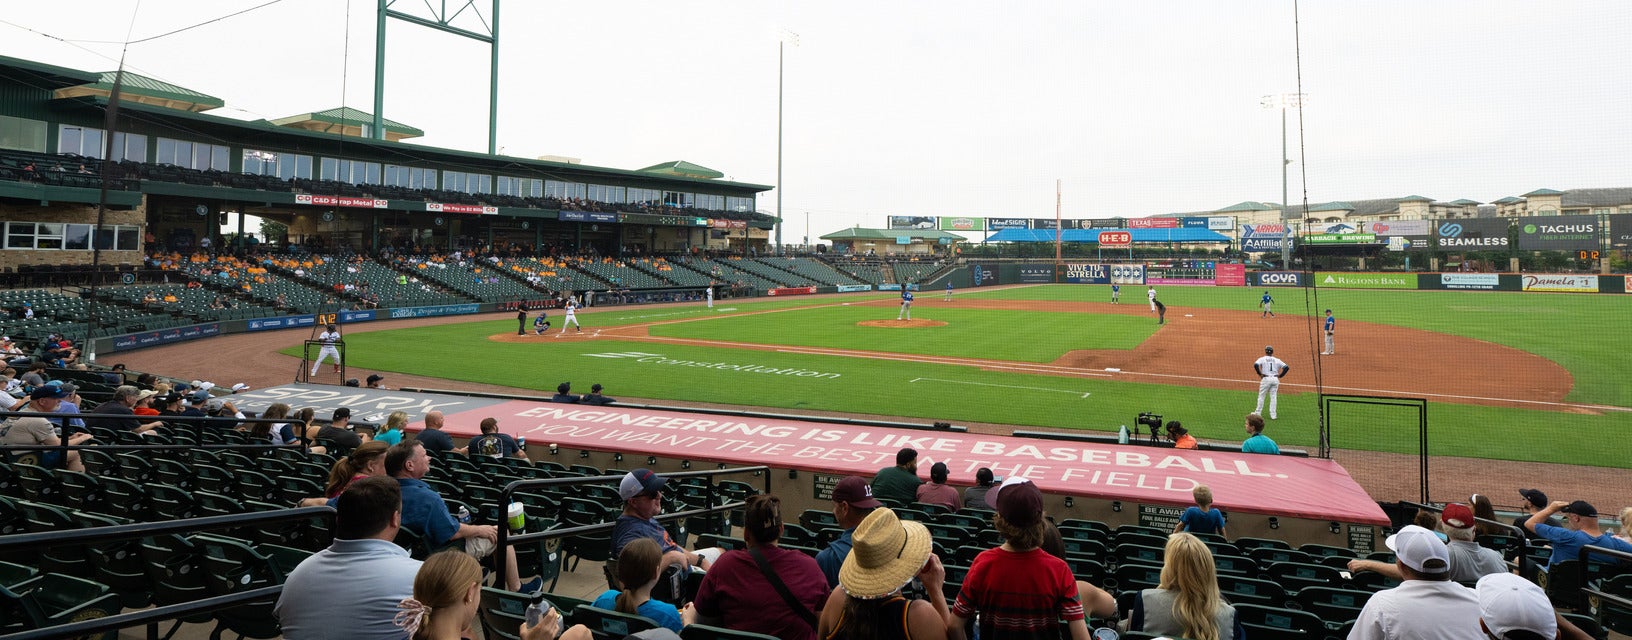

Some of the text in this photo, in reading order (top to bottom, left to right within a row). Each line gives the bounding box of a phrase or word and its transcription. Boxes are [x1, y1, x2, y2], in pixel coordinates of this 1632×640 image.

[331, 198, 352, 206] Scrap
[1255, 224, 1284, 232] ARROW
[1540, 224, 1594, 233] TACHUS
[1254, 239, 1293, 247] Affiliatd
[1439, 237, 1509, 246] SEAMLESS
[1261, 273, 1297, 284] GOYA
[1522, 275, 1575, 290] Pamela
[636, 356, 841, 379] Constellation
[514, 407, 1289, 479] ENGINEERING IS LIKE BASEBALL.
[526, 423, 607, 438] YOU
[599, 429, 717, 448] WANT
[714, 438, 795, 456] THE
[792, 446, 898, 465] BEST
[964, 459, 1052, 480] THE
[1060, 468, 1201, 492] FIELD
[864, 484, 873, 496] 12
[1144, 506, 1187, 516] BE AWAR
